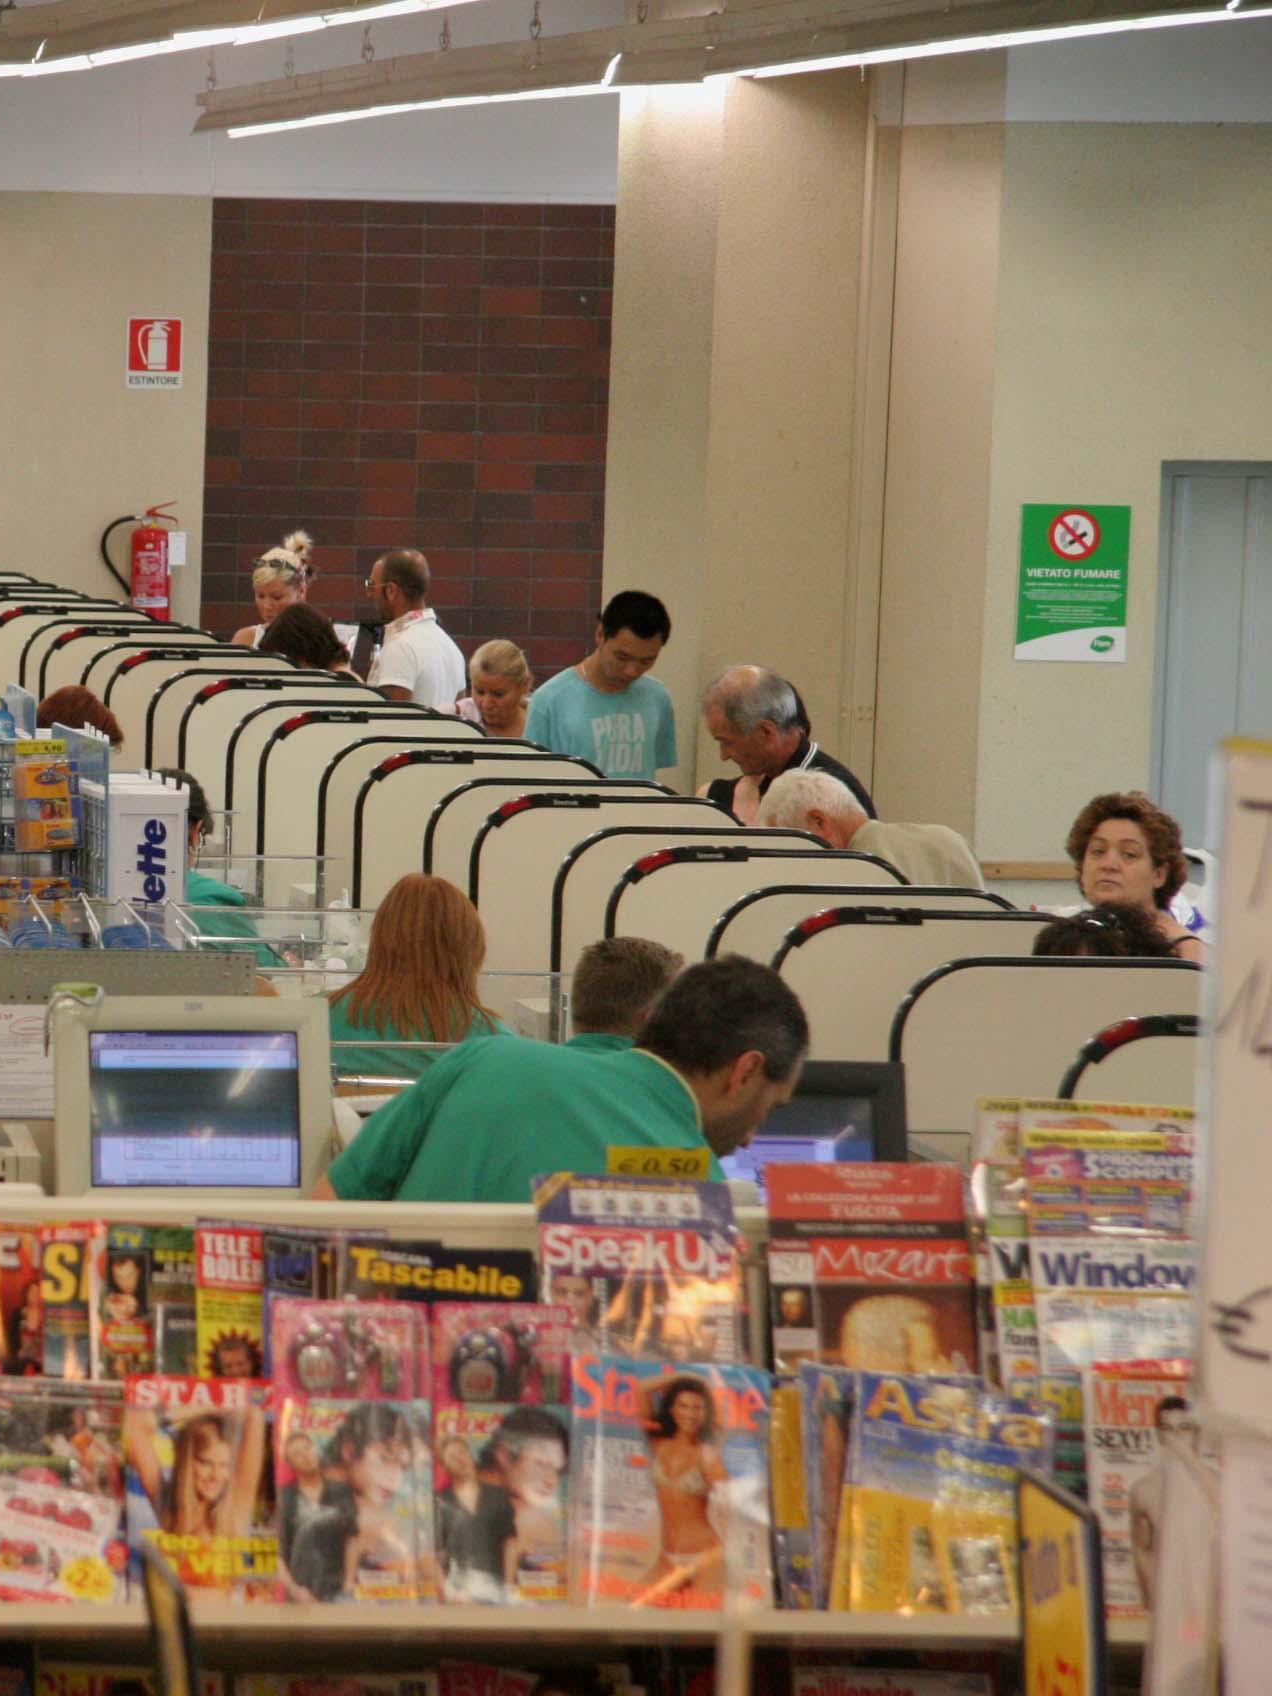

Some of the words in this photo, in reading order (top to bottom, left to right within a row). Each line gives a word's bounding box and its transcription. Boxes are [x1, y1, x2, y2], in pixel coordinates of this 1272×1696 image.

[128, 375, 180, 385] ESTINTORE
[1026, 567, 1072, 579] VIETATO
[1073, 568, 1121, 580] FUMARE
[132, 818, 167, 903] ette
[349, 1244, 523, 1297] Tascabile
[543, 1223, 672, 1276] Speak
[673, 1230, 733, 1281] Up
[815, 1243, 969, 1284] Mozart
[134, 1378, 247, 1409] STAR
[865, 1378, 1043, 1450] Astra
[1093, 1427, 1154, 1450] SEXY!
